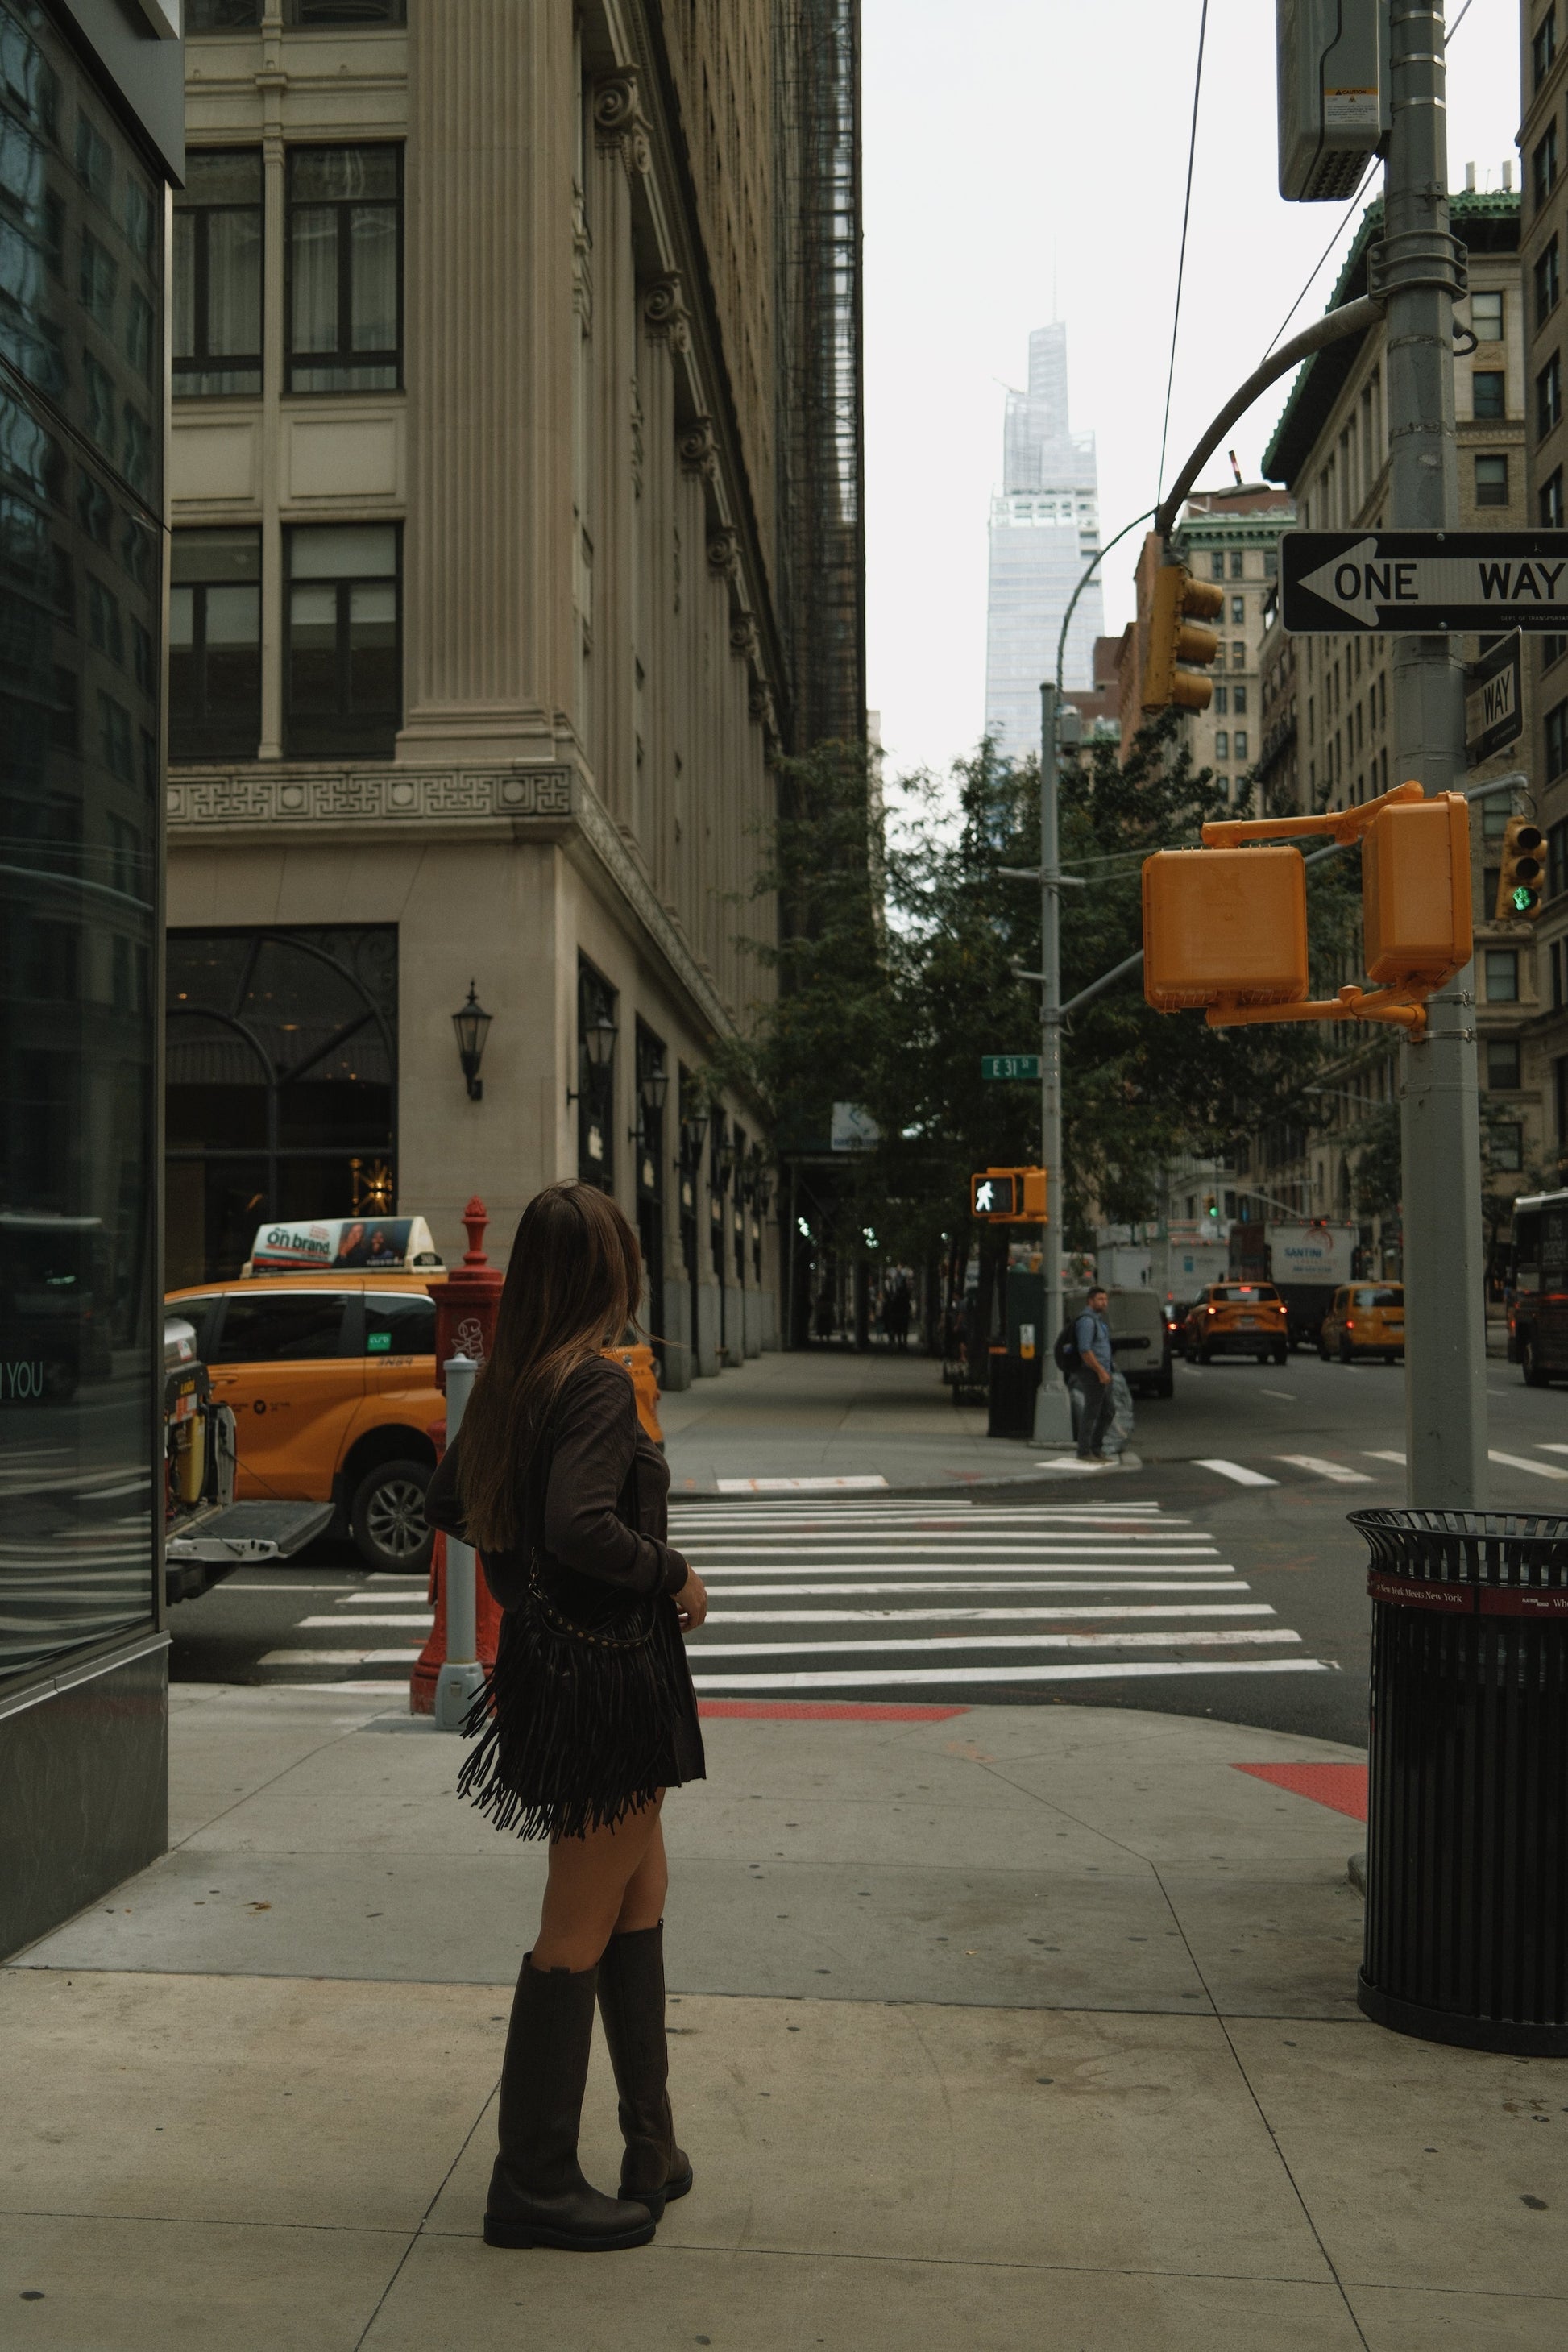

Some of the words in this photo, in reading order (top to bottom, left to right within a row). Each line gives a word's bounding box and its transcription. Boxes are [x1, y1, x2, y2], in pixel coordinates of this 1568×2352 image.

[1334, 563, 1419, 601] ONE
[1478, 562, 1566, 601] WAY
[1483, 670, 1511, 726] WAY
[993, 1058, 1000, 1076] E
[1005, 1058, 1017, 1076] 31
[1284, 1247, 1322, 1257] SANTINI
[6, 1361, 44, 1398] YOU
[1392, 1586, 1404, 1596] York
[1405, 1588, 1424, 1598] Meets
[1425, 1591, 1443, 1600] New
[1443, 1593, 1462, 1603] York
